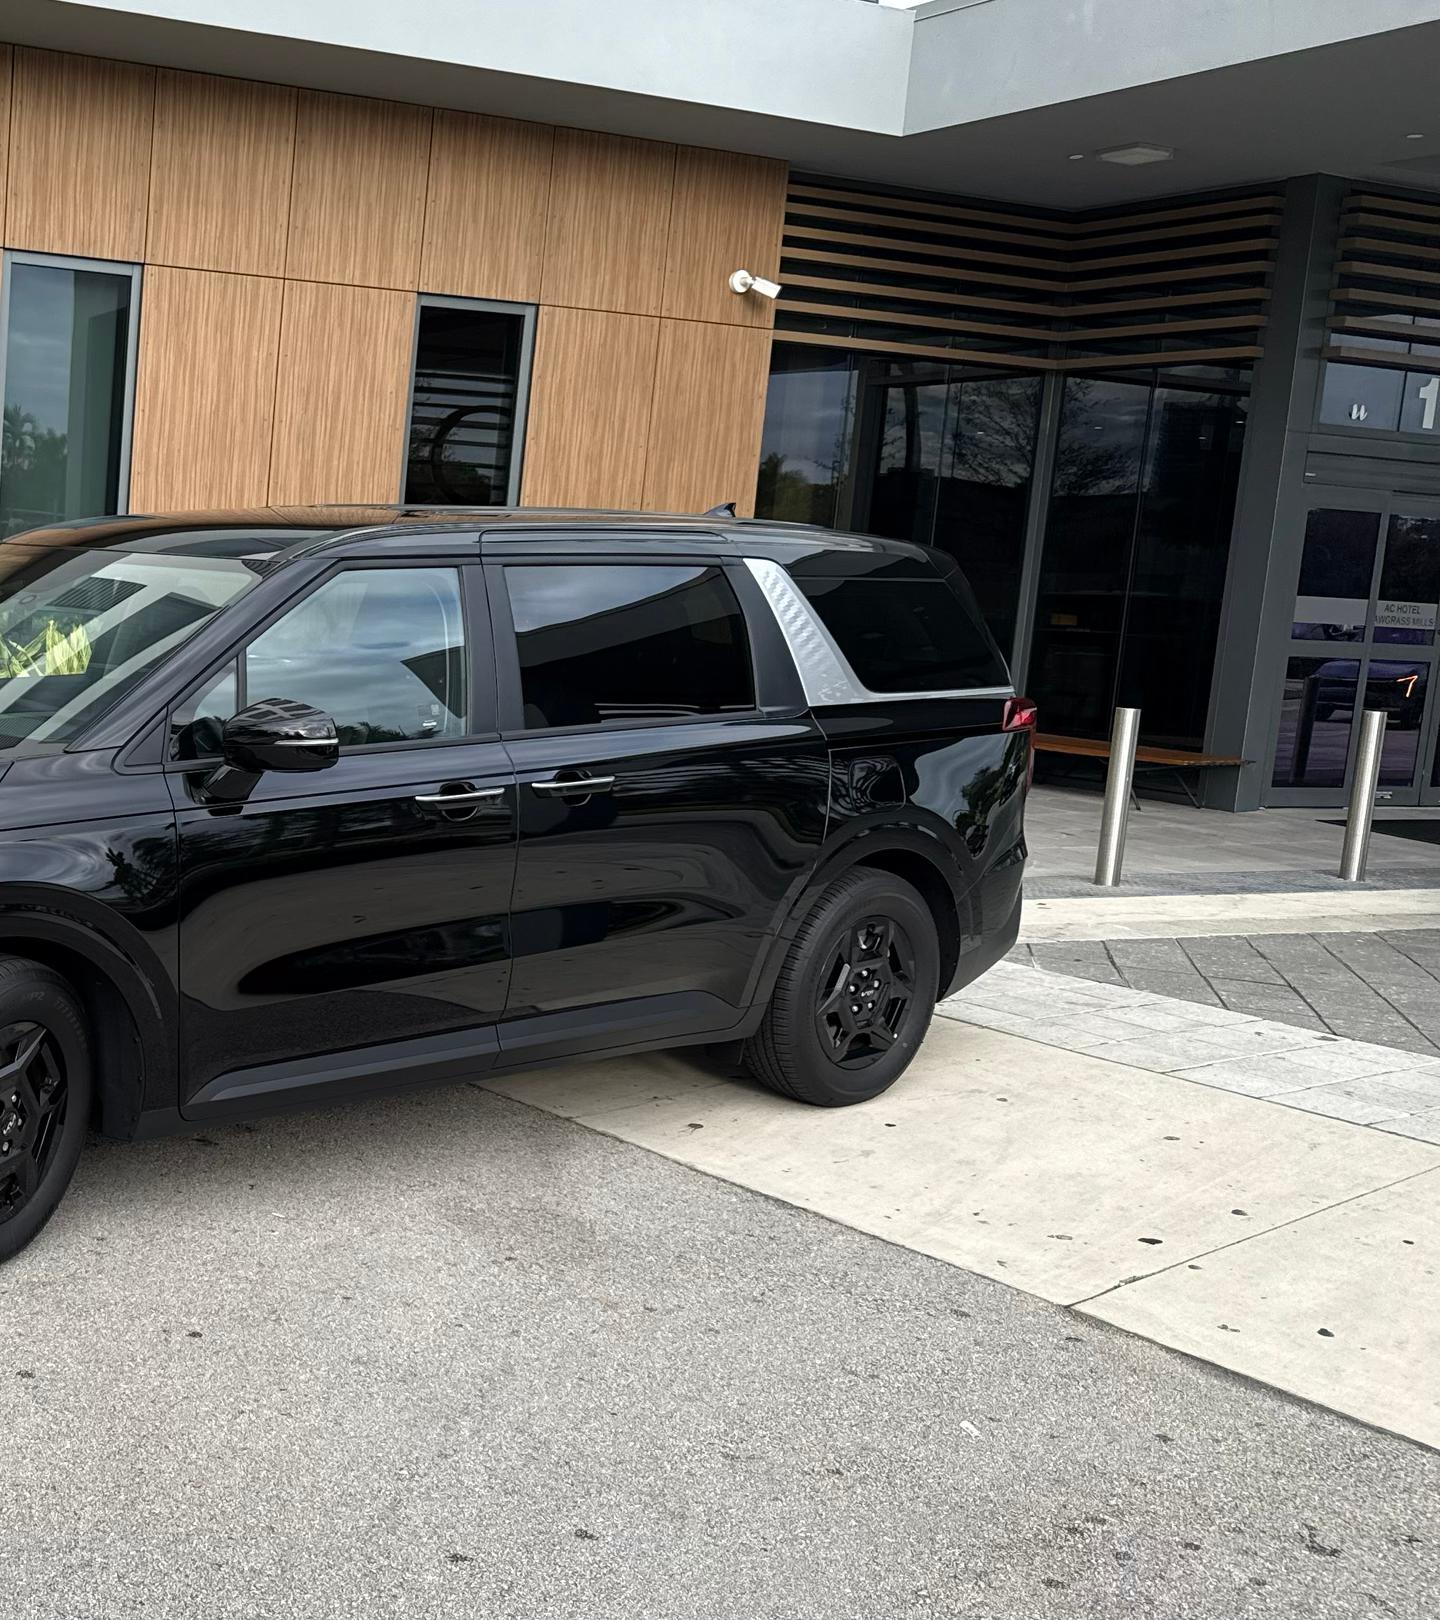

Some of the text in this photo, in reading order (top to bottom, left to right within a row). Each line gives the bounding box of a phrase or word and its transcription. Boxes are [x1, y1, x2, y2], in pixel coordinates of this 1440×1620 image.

[1419, 377, 1440, 430] 1
[1384, 604, 1421, 615] AC HOTEL
